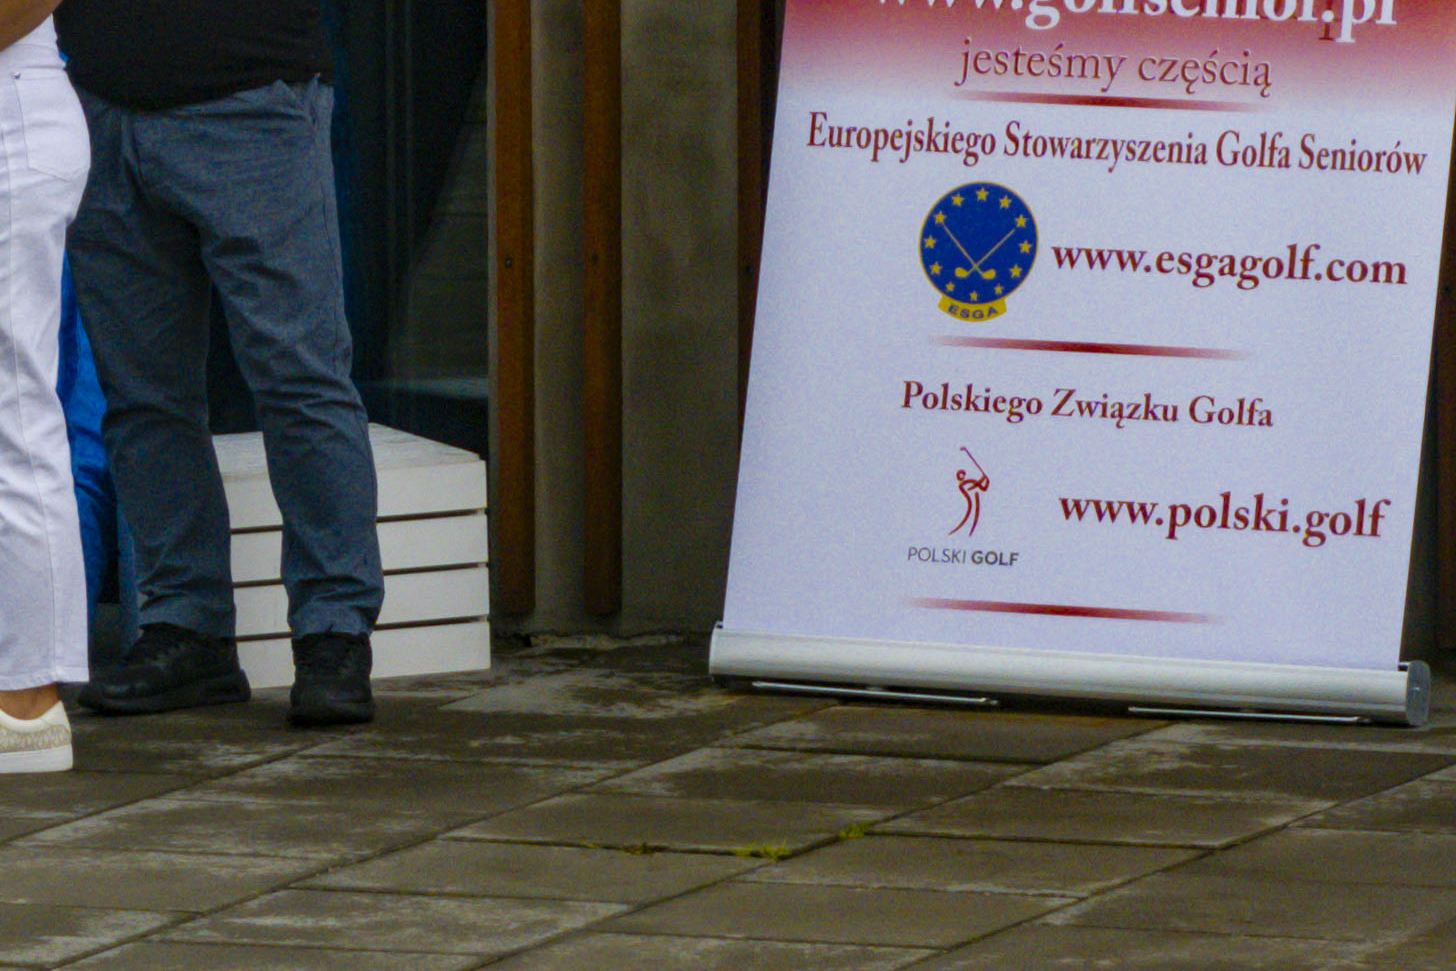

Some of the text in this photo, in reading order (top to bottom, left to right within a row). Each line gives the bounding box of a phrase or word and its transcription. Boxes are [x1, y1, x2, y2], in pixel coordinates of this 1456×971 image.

[954, 37, 1273, 98] jesteśmy częścią
[806, 111, 1428, 175] Europejskiego Stowarzyszenia Golfa Seniorów
[1051, 242, 1409, 292] www.esgagolf.com
[946, 303, 1000, 321] ESGA
[900, 379, 1274, 430] Polskiego Związku Golfa
[1058, 491, 1393, 549] www.polski.golf
[906, 546, 1020, 567] POLSKI GOLF
